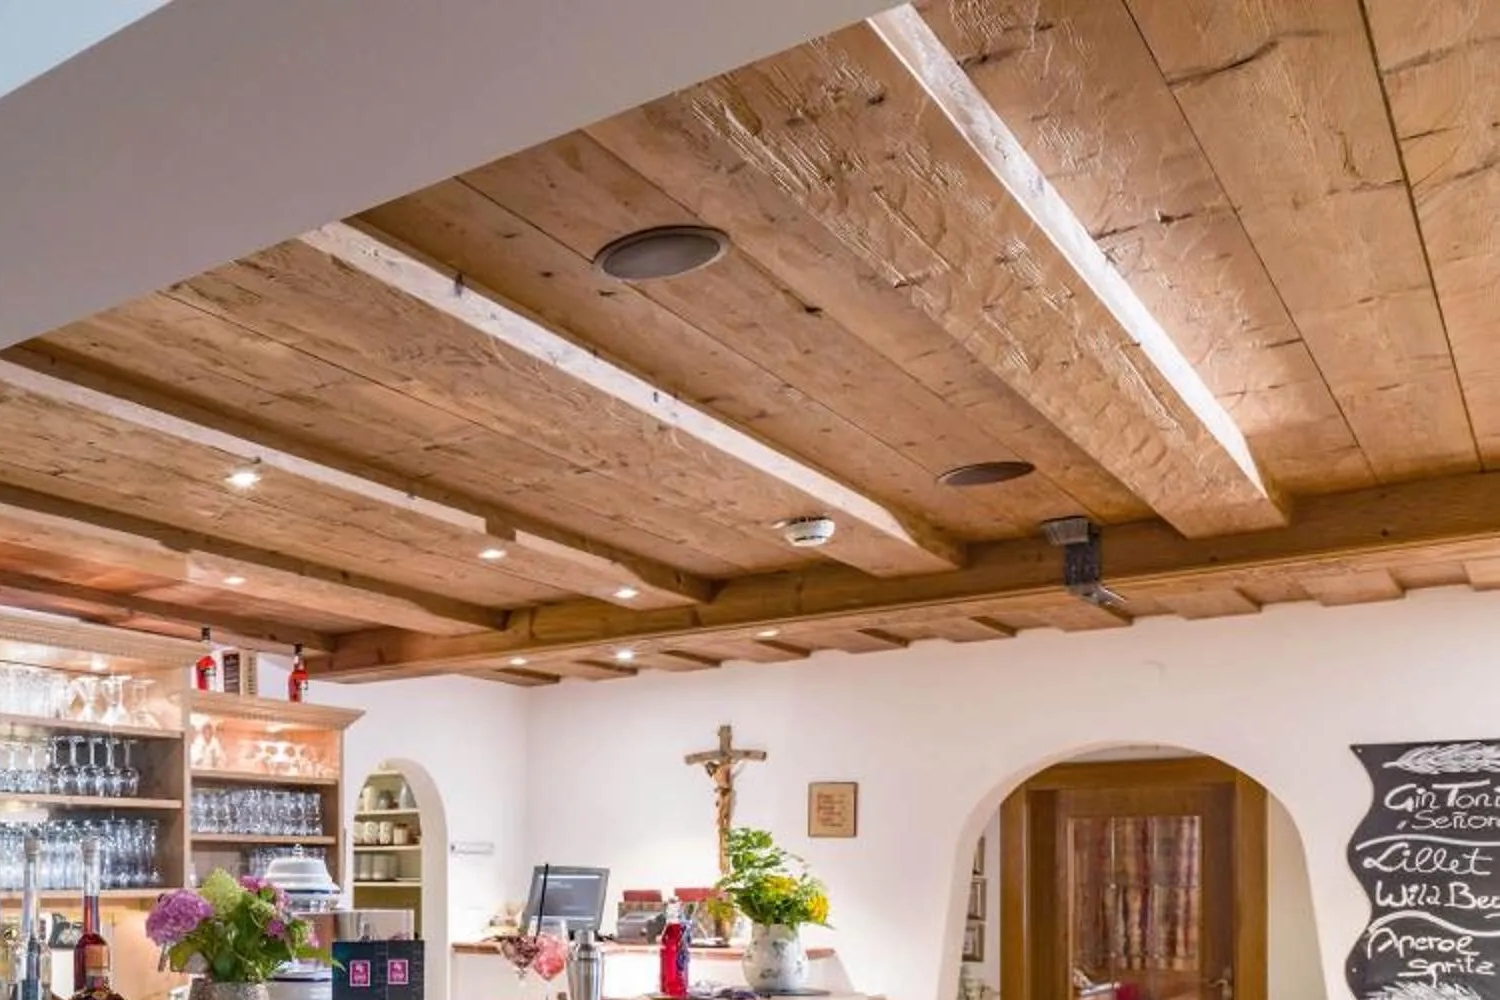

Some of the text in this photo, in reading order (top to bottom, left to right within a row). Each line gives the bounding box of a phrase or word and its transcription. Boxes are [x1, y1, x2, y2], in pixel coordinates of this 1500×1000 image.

[1384, 783, 1440, 812] Gin
[1363, 841, 1493, 875] Lillet
[1375, 880, 1442, 908] Wild
[1366, 927, 1480, 959] Aperol
